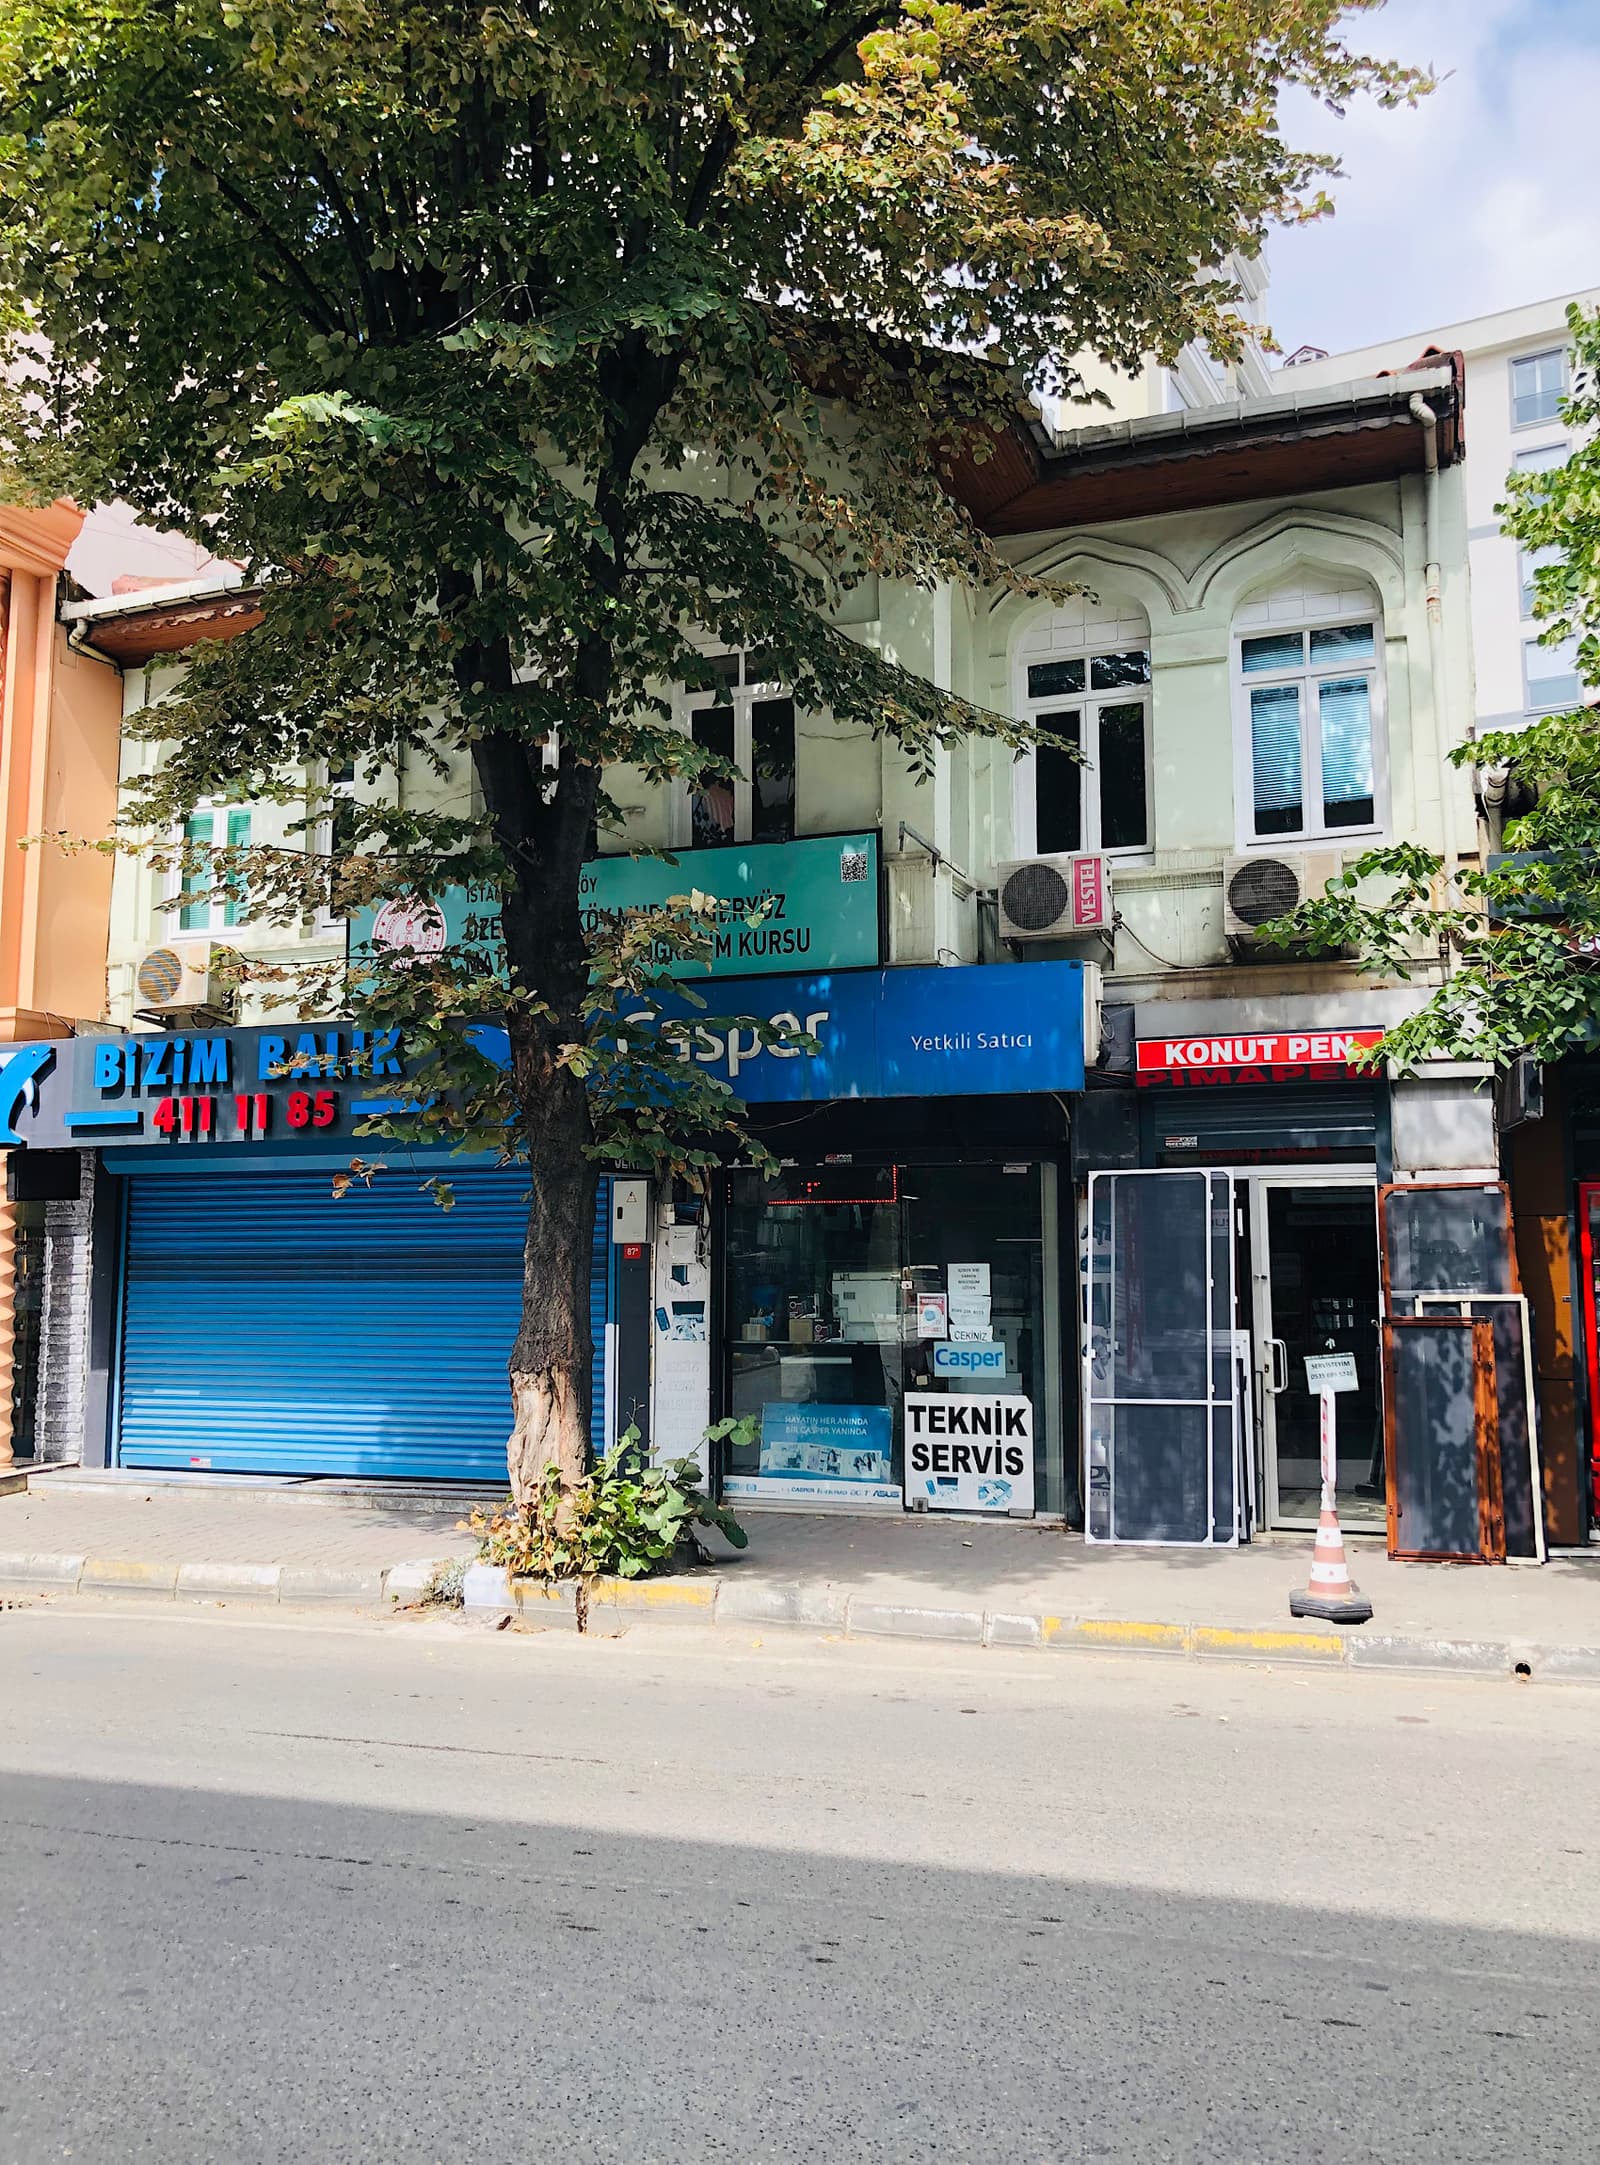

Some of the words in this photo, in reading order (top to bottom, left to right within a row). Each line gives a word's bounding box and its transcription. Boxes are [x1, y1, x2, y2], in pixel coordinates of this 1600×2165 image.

[1081, 858, 1097, 923] VESTEL
[738, 927, 811, 957] KURSU
[911, 1034, 971, 1052] Yetkili
[1165, 1038, 1278, 1065] KONUT
[1288, 1035, 1355, 1060] PEN
[152, 1096, 212, 1133] 411
[235, 1093, 268, 1131] 11
[286, 1090, 336, 1128] 85
[935, 1348, 1003, 1372] Casper
[784, 1414, 818, 1425] HAYATIN
[820, 1417, 836, 1425] HER
[837, 1416, 869, 1426] ANINDA
[800, 1426, 830, 1436] CASPER
[831, 1426, 868, 1436] YANINDA
[907, 1400, 1028, 1437] TEKNİK
[911, 1439, 1024, 1476] SERVİS
[872, 1489, 900, 1498] ASUS
